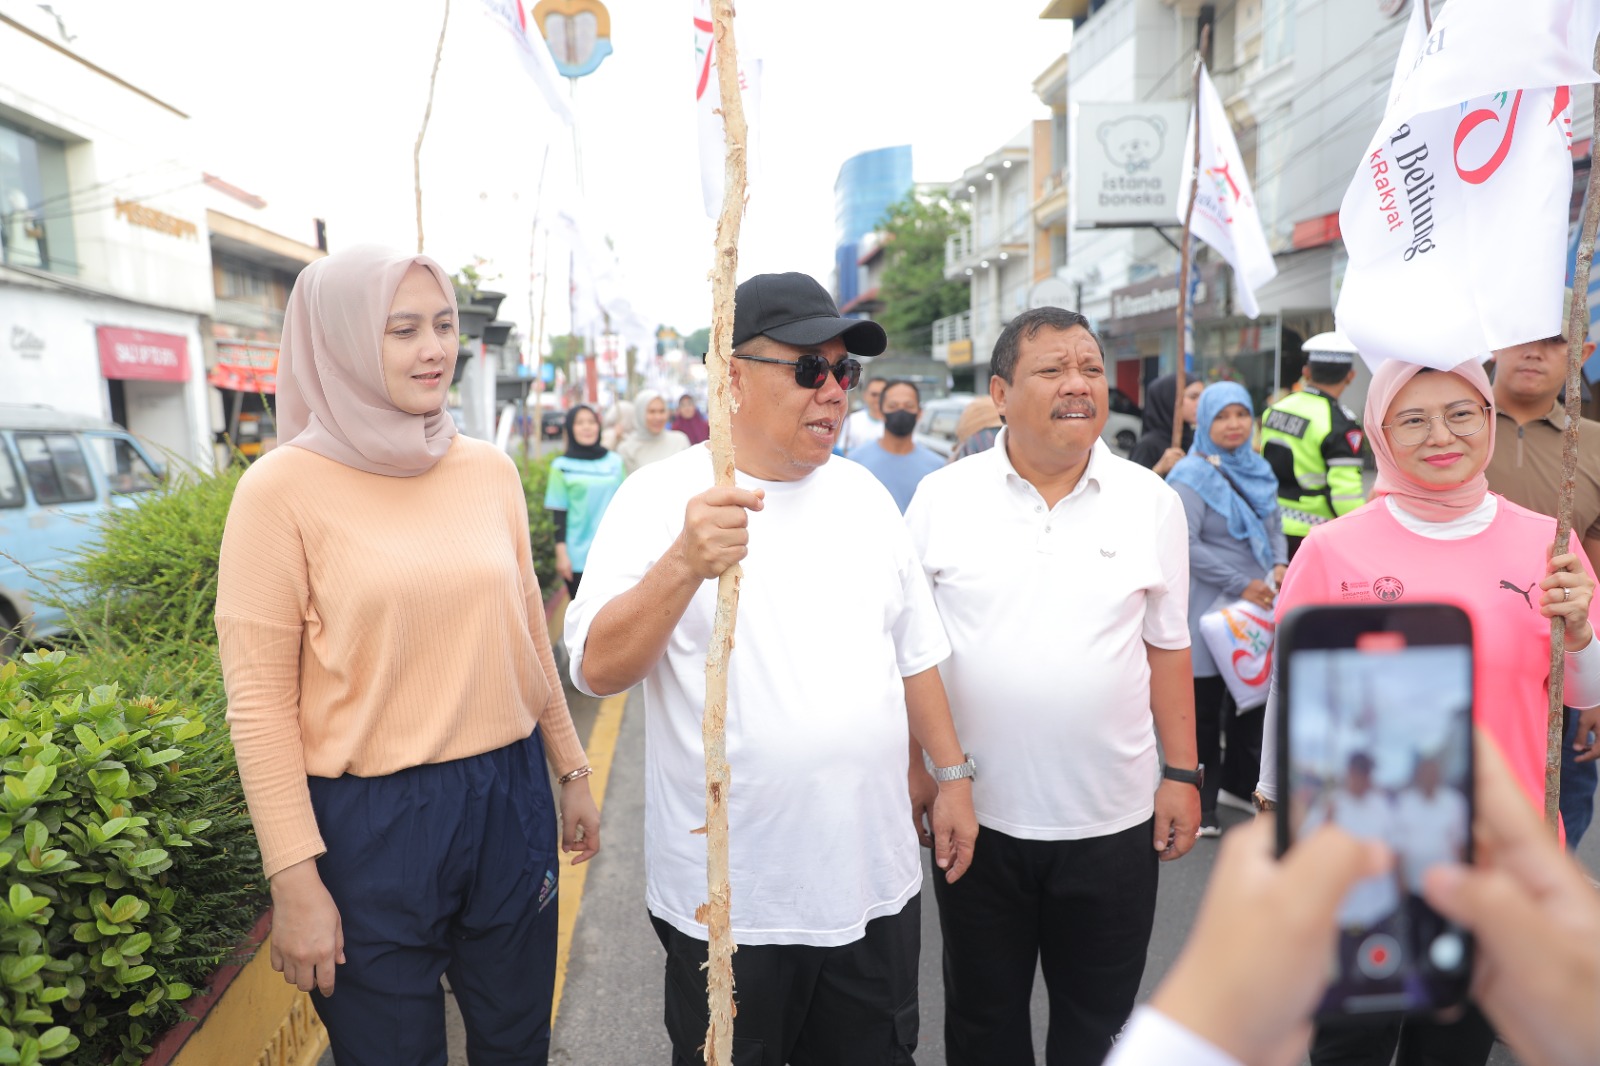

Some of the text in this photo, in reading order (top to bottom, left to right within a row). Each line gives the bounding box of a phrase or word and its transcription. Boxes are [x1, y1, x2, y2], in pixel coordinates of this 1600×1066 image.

[1102, 172, 1162, 191] istana
[1370, 148, 1404, 232] kRakyat
[1098, 192, 1167, 207] boneka
[1395, 141, 1436, 262] Belitung
[1266, 410, 1306, 436] POLISI
